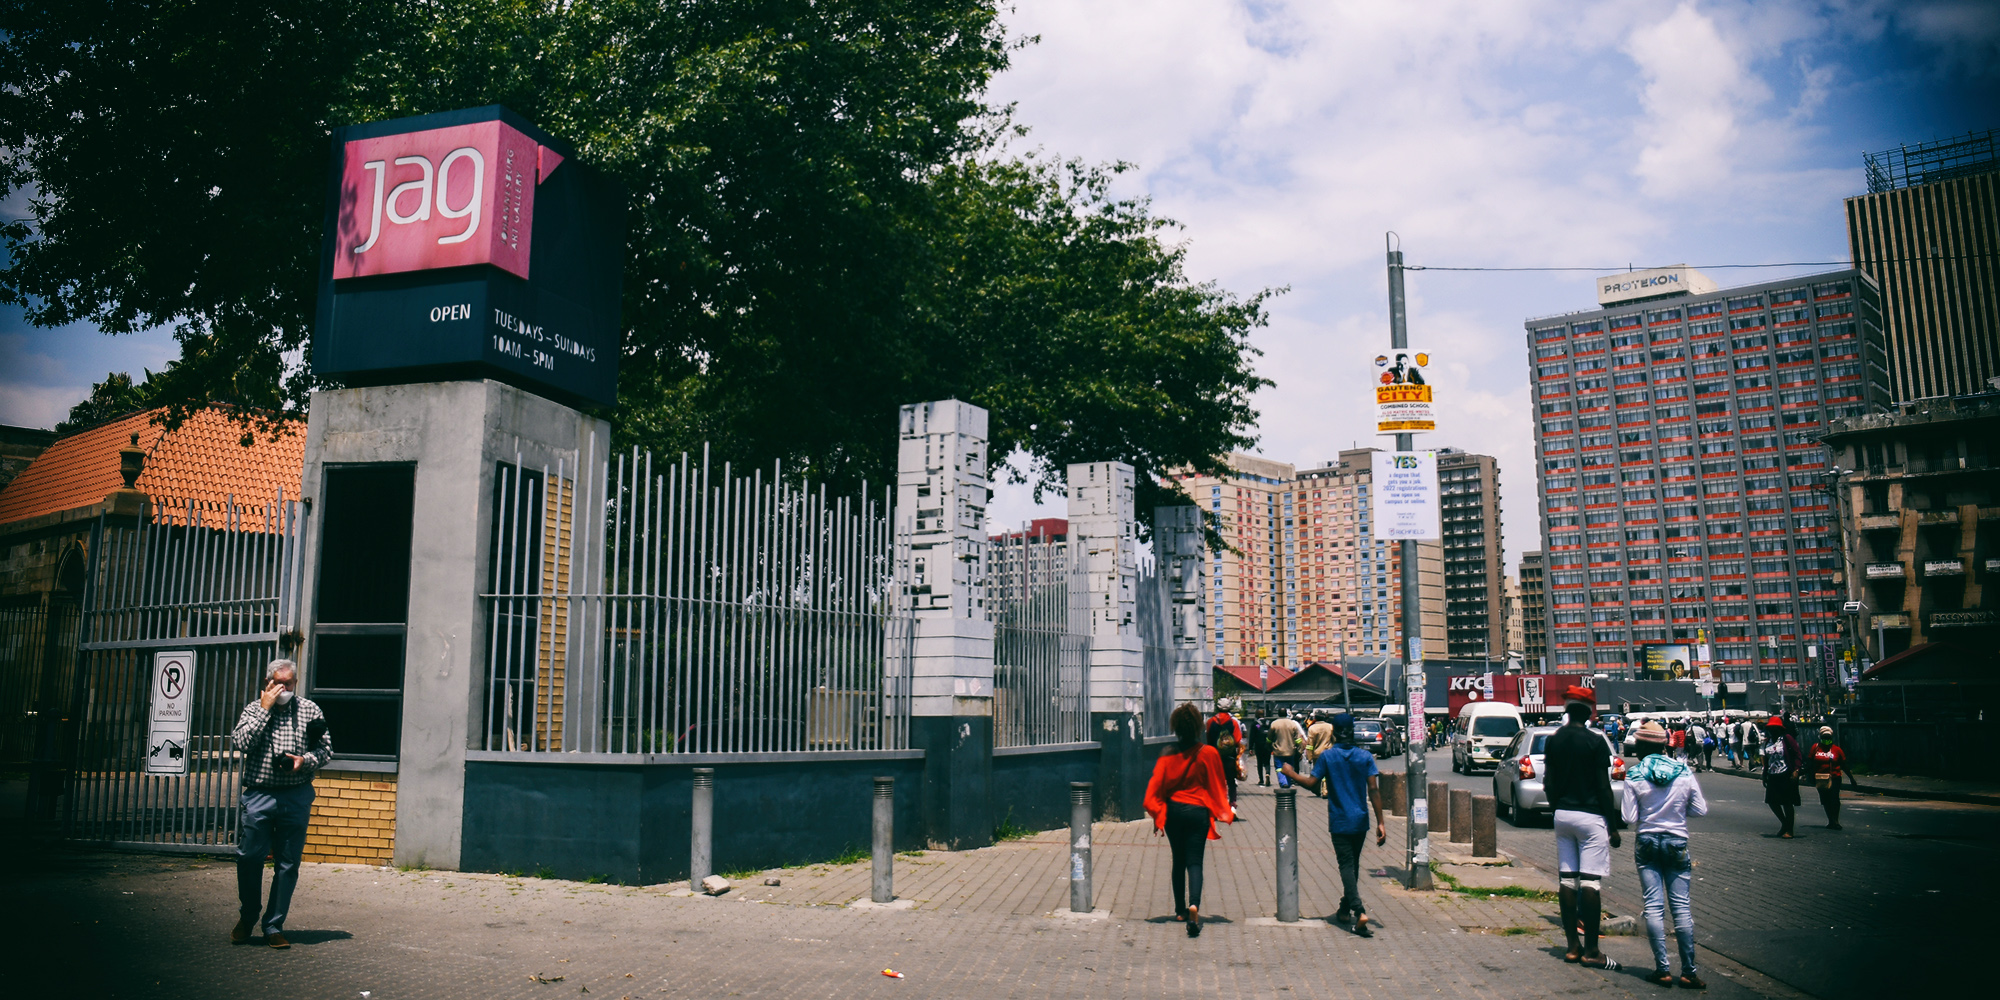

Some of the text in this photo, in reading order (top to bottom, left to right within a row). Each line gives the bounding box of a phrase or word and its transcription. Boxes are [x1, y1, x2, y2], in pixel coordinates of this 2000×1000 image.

[354, 146, 485, 254] jag
[501, 149, 515, 246] JOHANNESBURG
[514, 171, 523, 224] GALLERY
[511, 227, 519, 251] ART
[1604, 273, 1678, 294] PROTEKON
[430, 303, 471, 323] OPEN
[494, 308, 544, 342] TUESDAYS
[554, 333, 596, 363] SUNDAYS
[492, 334, 522, 359] 10AM
[532, 349, 554, 371] 5PM
[1378, 391, 1423, 401] CITY
[1392, 455, 1418, 469] YES
[1823, 644, 1837, 685] NOORD
[1450, 677, 1485, 691] KFC
[1581, 676, 1596, 689] KFC
